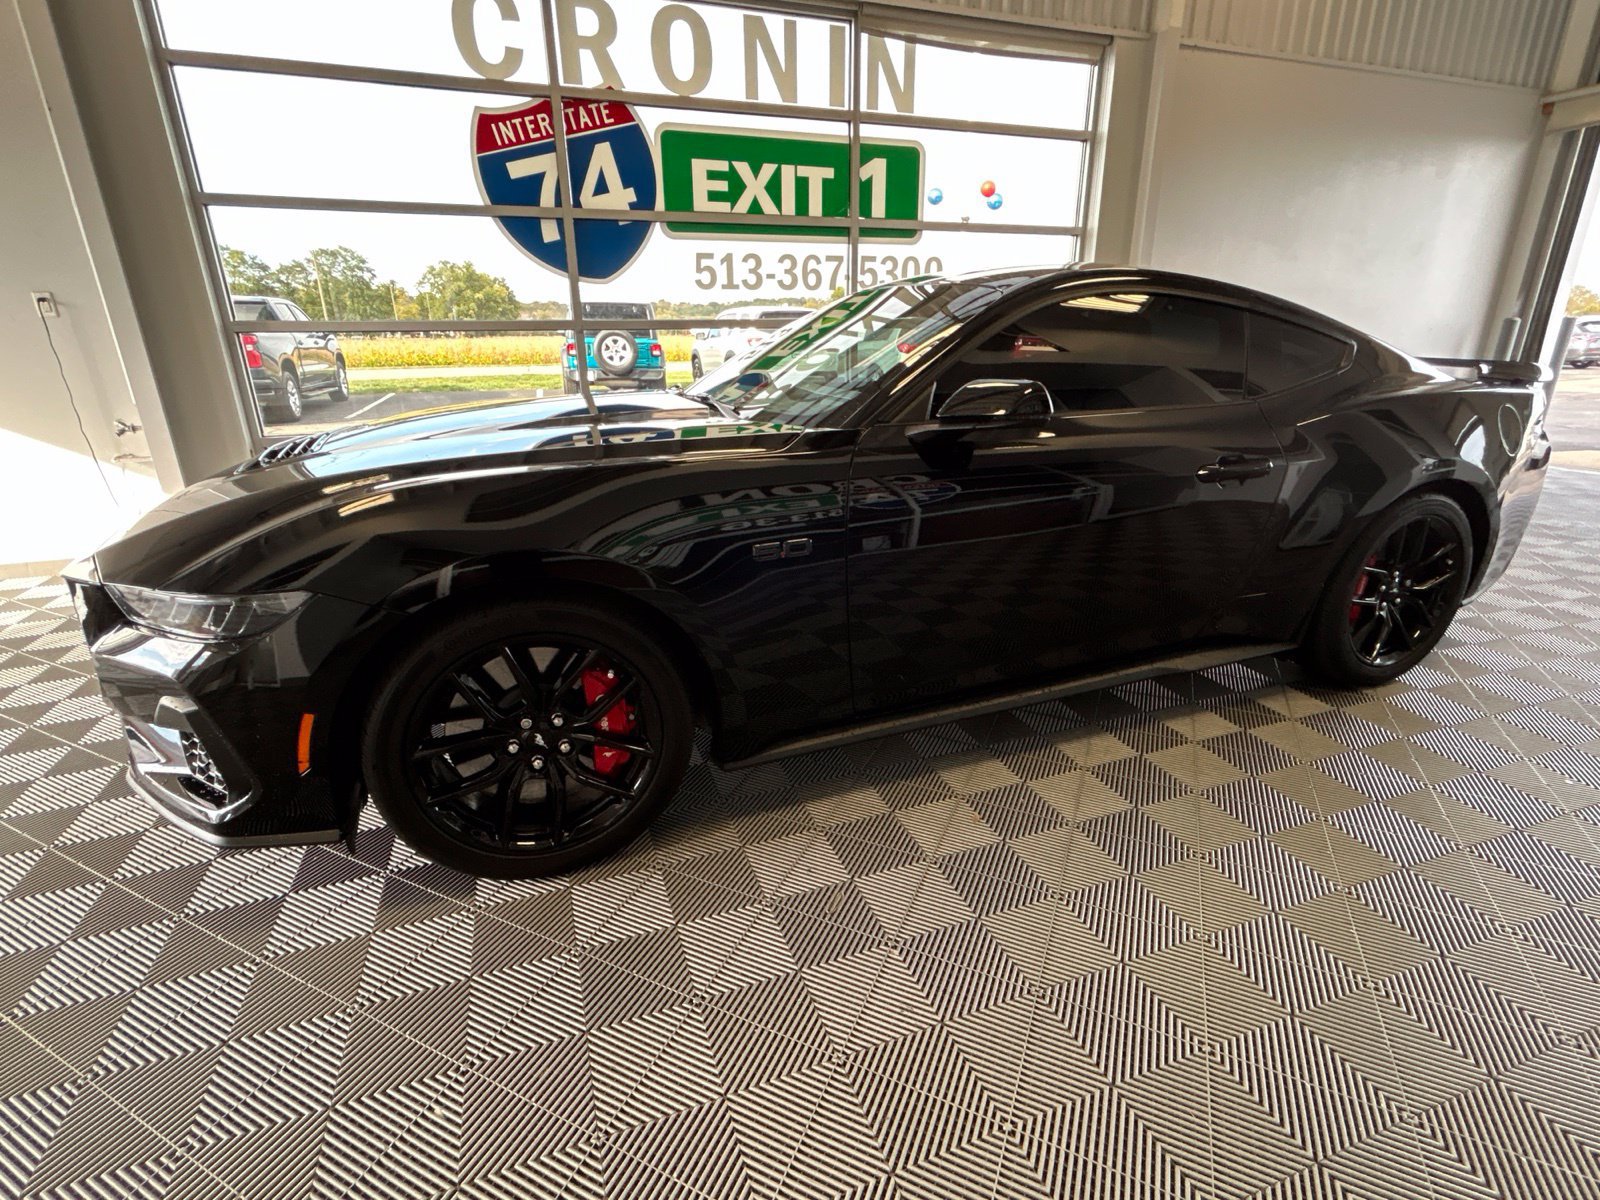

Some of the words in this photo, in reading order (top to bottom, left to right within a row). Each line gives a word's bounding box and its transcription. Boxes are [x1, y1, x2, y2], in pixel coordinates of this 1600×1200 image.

[451, 0, 917, 114] CRONIN
[490, 101, 615, 147] INTERTATE
[505, 141, 638, 243] 74
[691, 158, 835, 217] EXIT
[859, 157, 887, 218] 1
